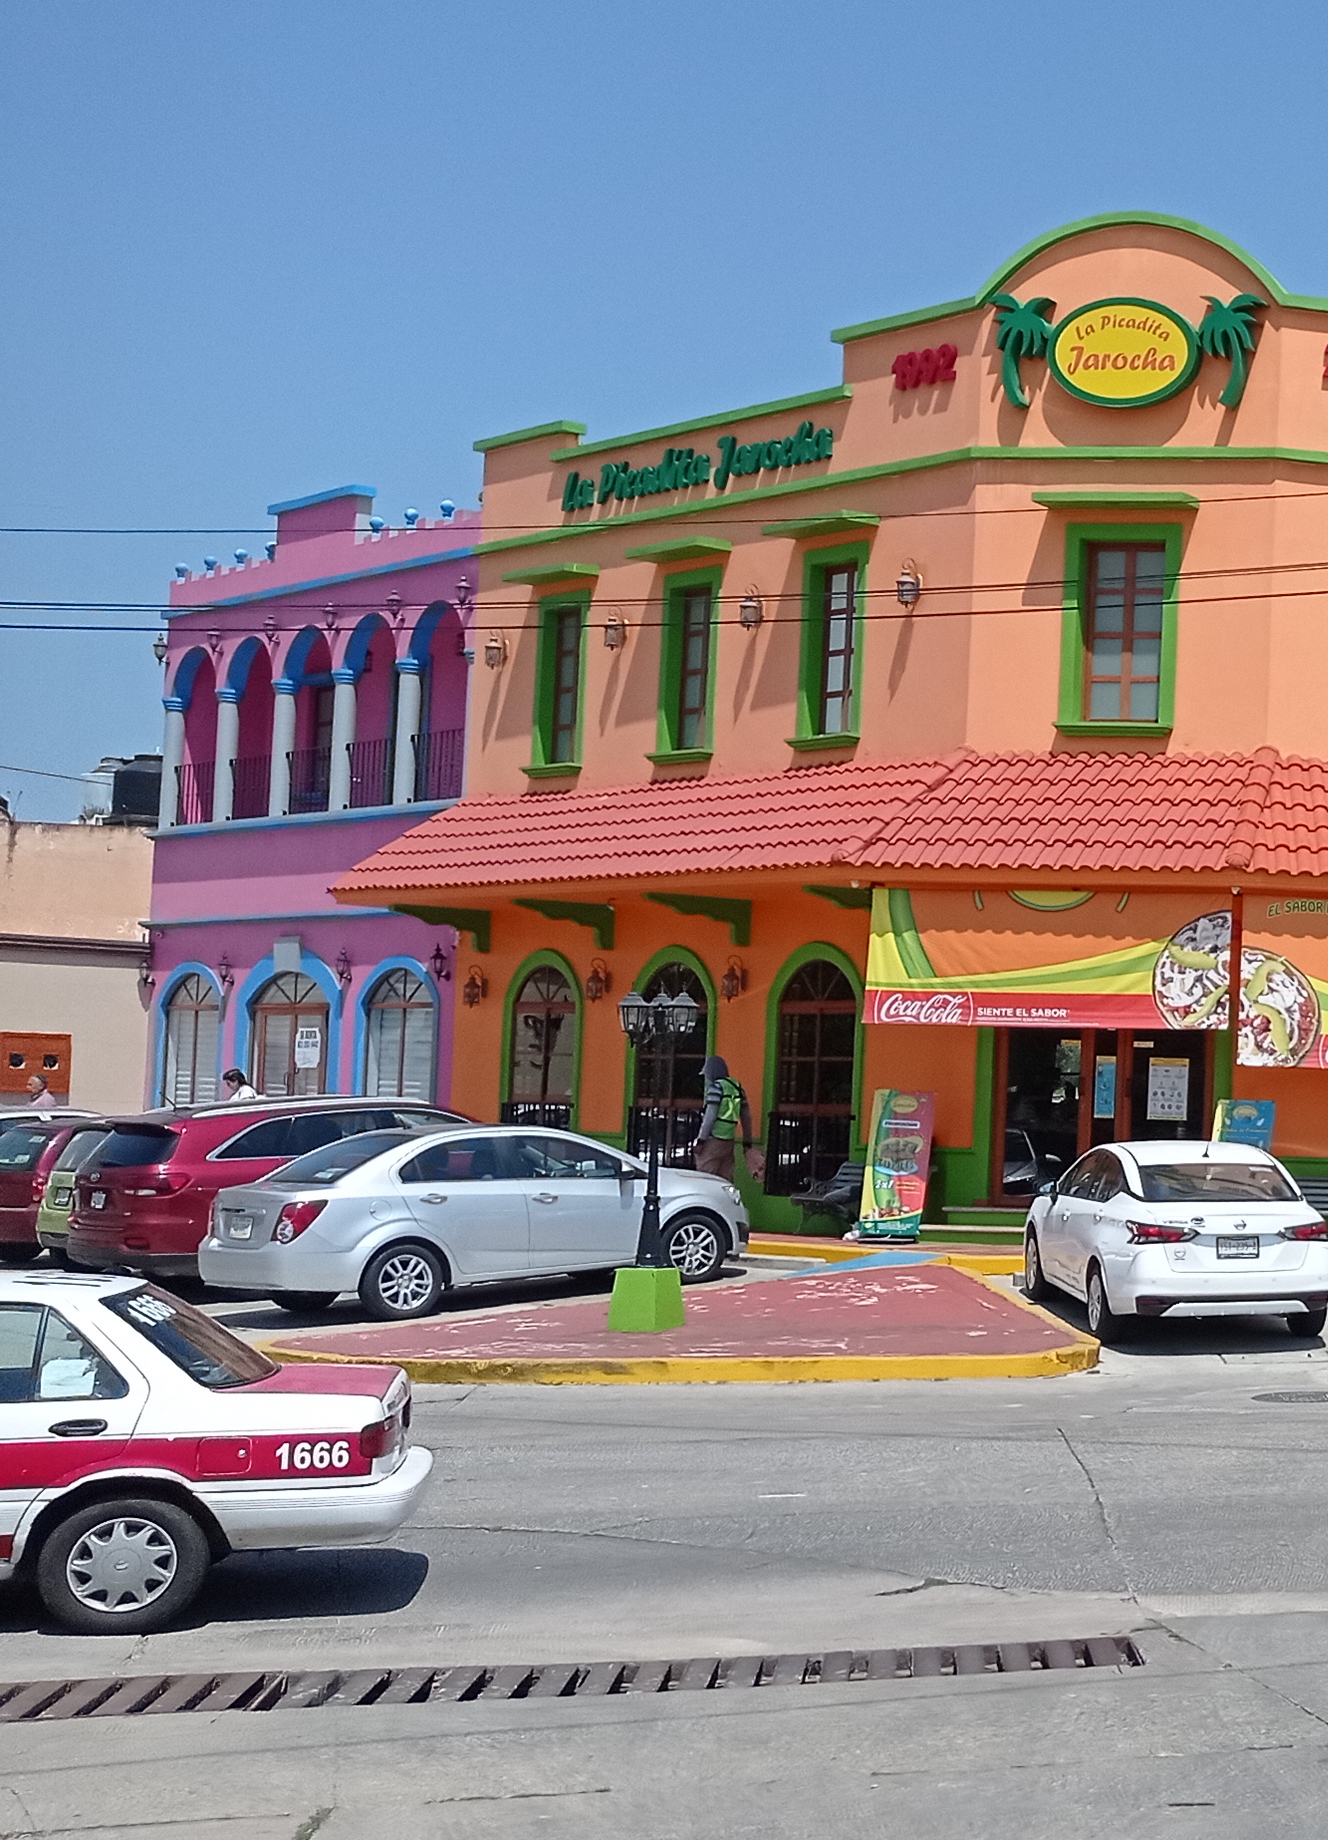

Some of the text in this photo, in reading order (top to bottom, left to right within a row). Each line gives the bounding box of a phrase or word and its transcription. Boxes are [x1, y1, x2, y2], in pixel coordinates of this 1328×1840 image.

[1075, 315, 1171, 342] La Picadita
[1067, 345, 1176, 376] Jarocha
[562, 420, 833, 512] La Picadita Jarocha
[1268, 906, 1281, 917] EL
[1285, 900, 1323, 914] SABOR
[880, 993, 968, 1023] Coca-Cola
[977, 1007, 1068, 1018] SIENTE EL SABOR
[275, 1440, 350, 1470] 1666
